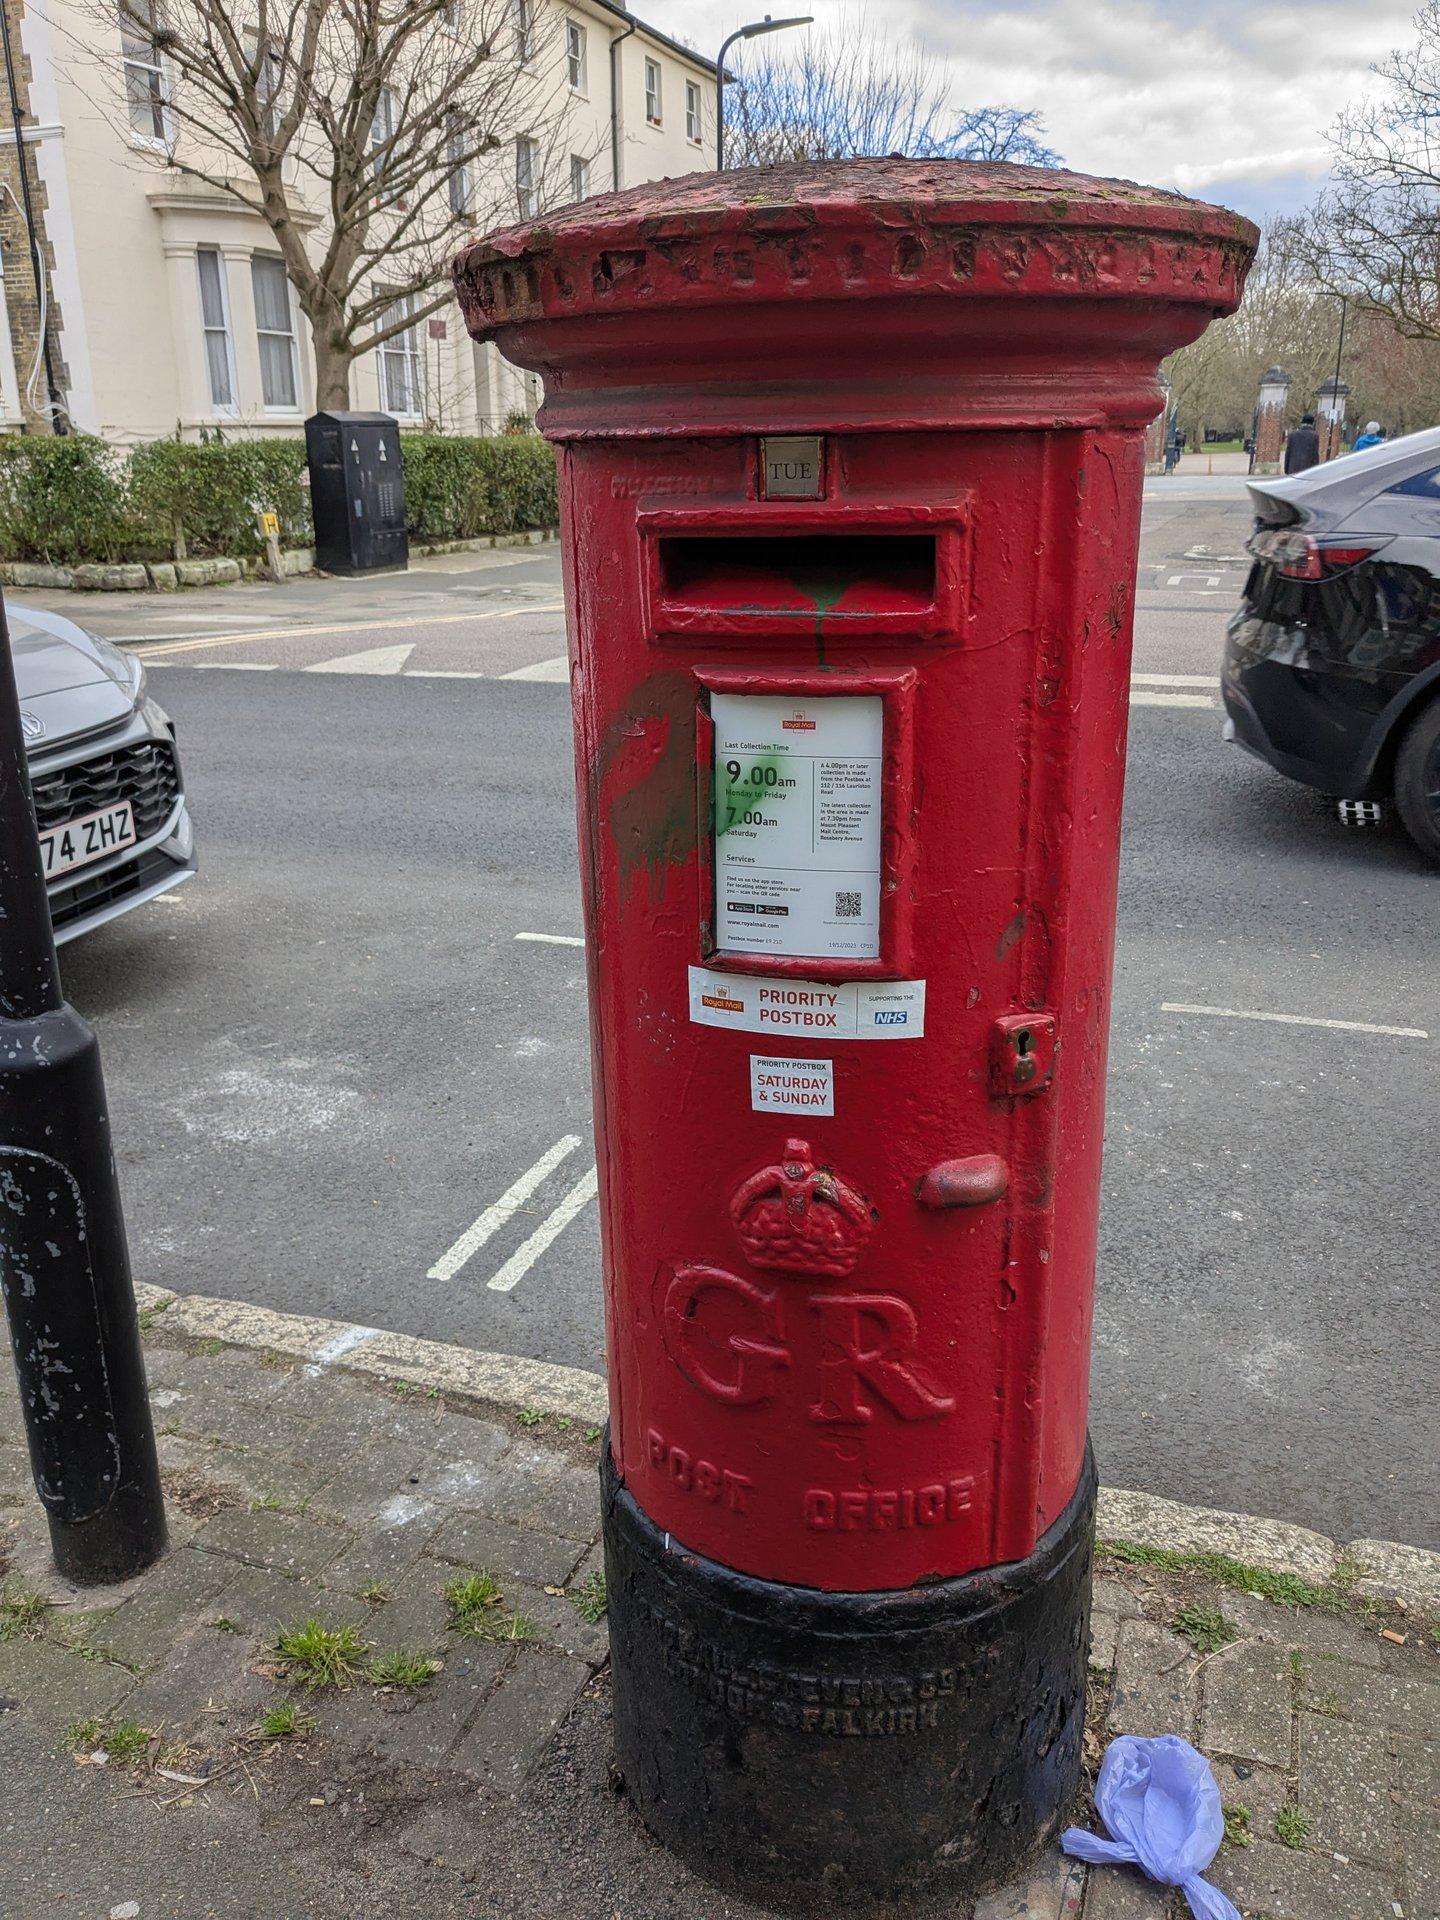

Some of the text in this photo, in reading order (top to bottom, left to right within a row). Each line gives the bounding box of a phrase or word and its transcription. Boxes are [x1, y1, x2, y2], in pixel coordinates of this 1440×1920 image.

[769, 463, 812, 479] TUE
[740, 742, 772, 750] Collection
[726, 760, 796, 787] 9.00am
[725, 789, 753, 798] Monday
[764, 791, 787, 800] Friday
[726, 807, 778, 826] 7.00am
[82, 808, 132, 855] ZHZ
[726, 829, 758, 838] Saturday
[726, 854, 756, 863] Services
[727, 919, 780, 929] www.royalmail.com
[703, 997, 742, 1010] Royal Mail
[759, 988, 838, 1007] PRIORITY
[760, 1008, 837, 1027] POSTBOX
[875, 1012, 906, 1023] NHS
[757, 1060, 827, 1071] PRIORITY POSTBOX
[757, 1074, 827, 1090] SATURDAY
[759, 1090, 827, 1105] & SUNDAY
[648, 1427, 974, 1530] POST OFFICE
[800, 1702, 939, 1737] FALKIRK
